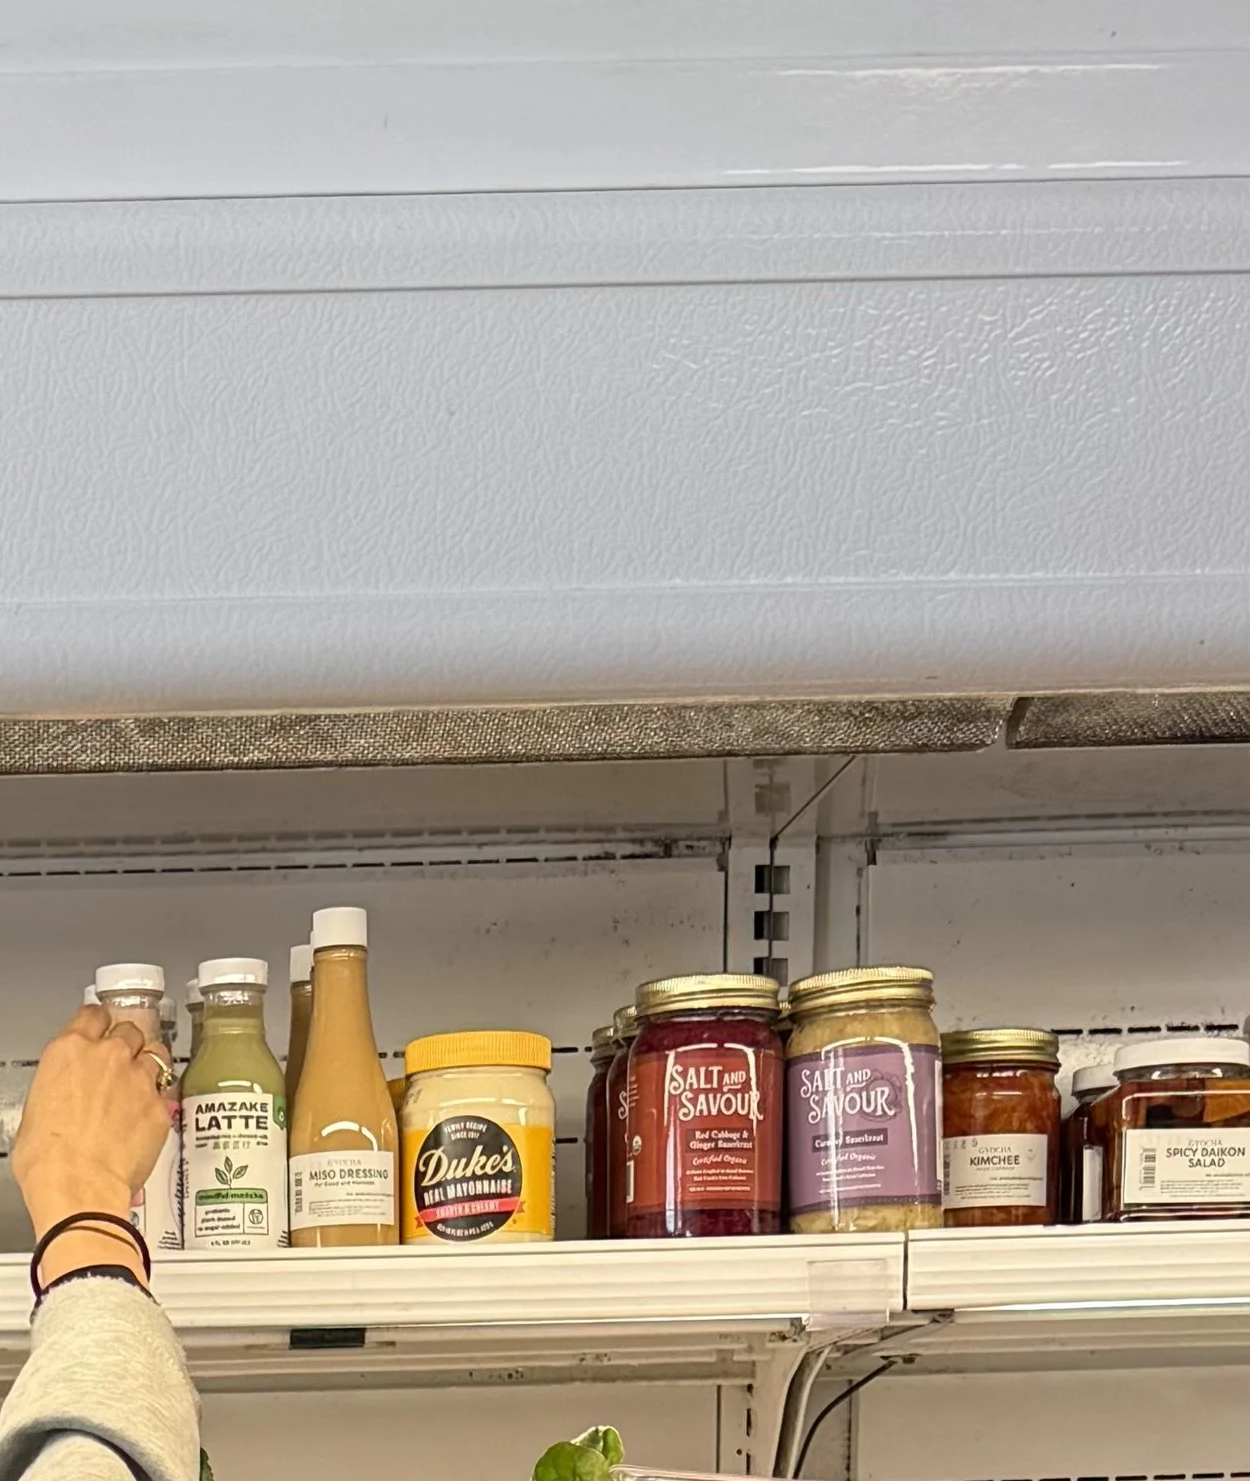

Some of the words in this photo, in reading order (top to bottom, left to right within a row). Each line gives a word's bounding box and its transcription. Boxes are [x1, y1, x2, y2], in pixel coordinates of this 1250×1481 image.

[669, 1064, 722, 1095] SALT
[722, 1070, 747, 1090] AND
[801, 1067, 845, 1098] SALT
[846, 1069, 871, 1090] AND
[195, 1102, 268, 1115] AMAZAKE
[678, 1091, 764, 1121] SAVOUR
[808, 1087, 895, 1124] SAVOUR
[195, 1115, 268, 1132] LATTE
[969, 1155, 1020, 1166] KIMCHEE
[1166, 1147, 1197, 1158] SPICY
[1200, 1147, 1246, 1157] DAIKON
[1188, 1158, 1225, 1168] SALAD
[309, 1169, 336, 1181] MISO
[419, 1145, 515, 1187] Duke's
[424, 1187, 445, 1206] REAL
[447, 1179, 512, 1199] MAYONNAISE
